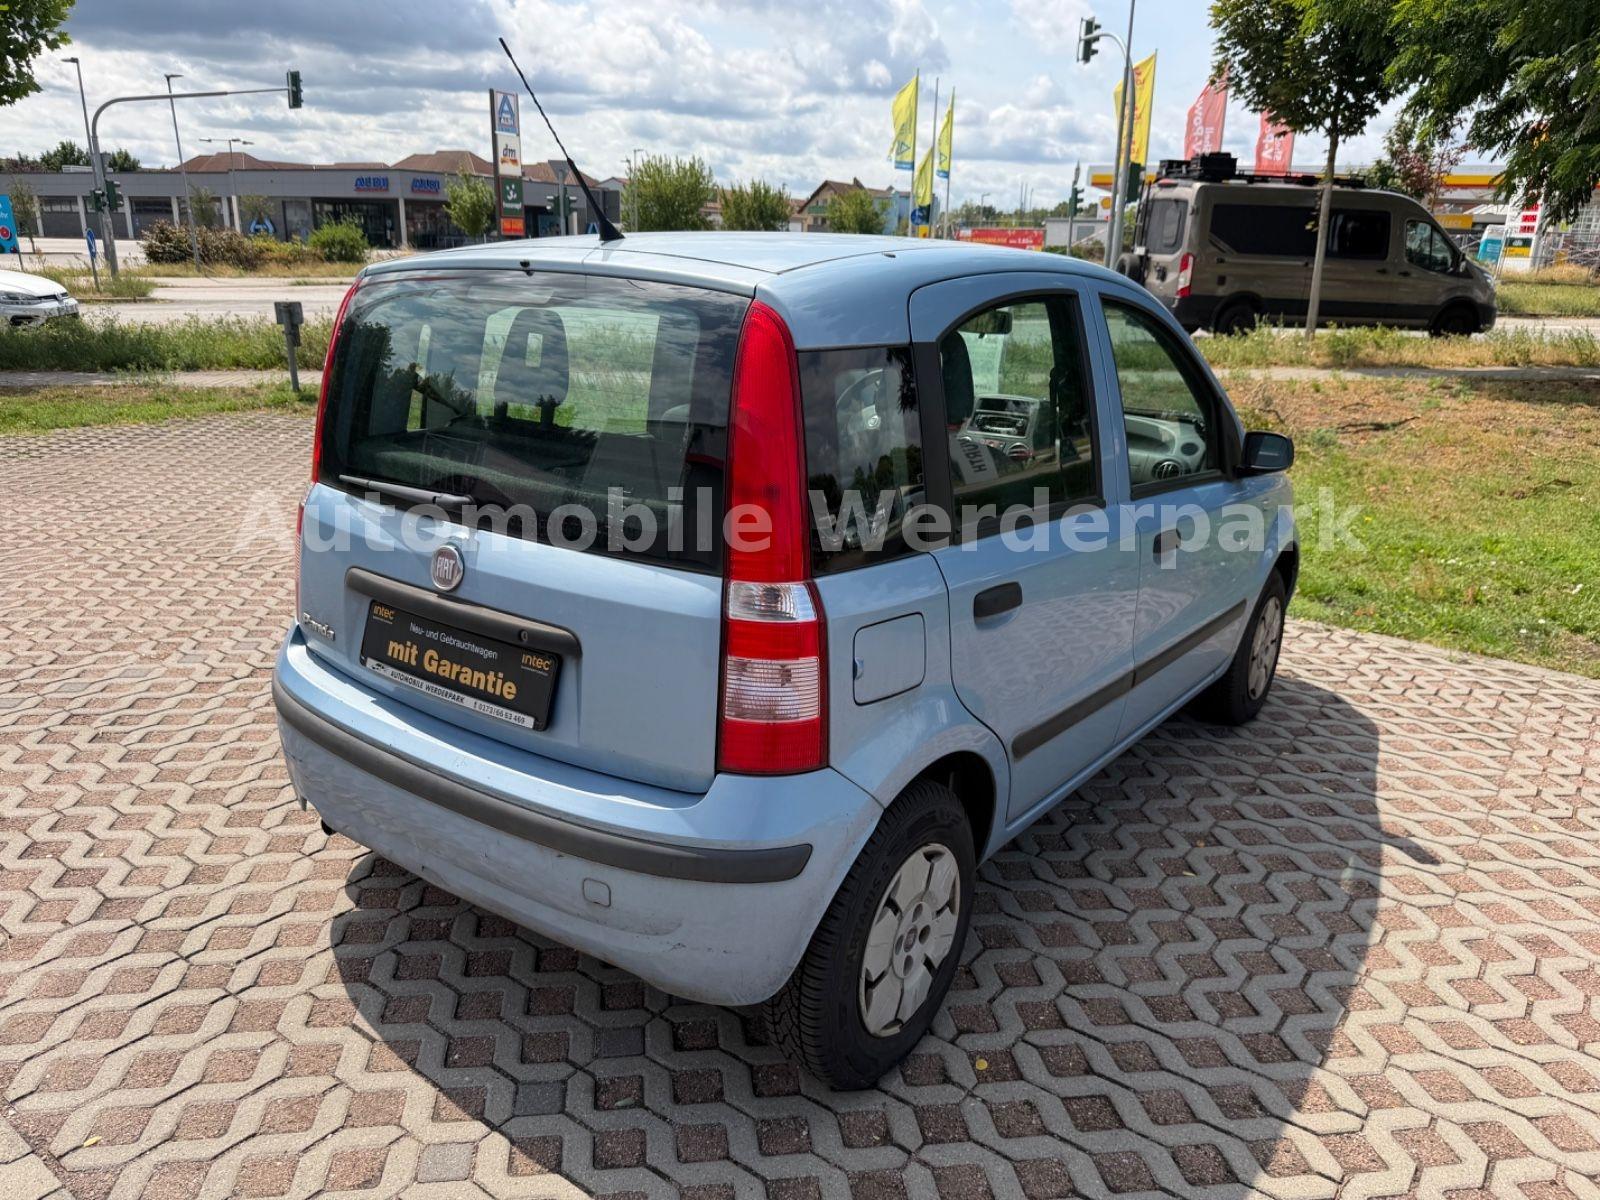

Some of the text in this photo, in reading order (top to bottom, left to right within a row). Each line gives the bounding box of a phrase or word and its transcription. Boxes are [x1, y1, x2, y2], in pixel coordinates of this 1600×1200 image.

[436, 556, 456, 580] FIAT
[373, 605, 395, 620] intec
[426, 630, 438, 640] und
[440, 632, 498, 660] Gebrauchtwagen
[387, 640, 517, 700] mit Garantie
[522, 653, 551, 671] intec
[390, 670, 424, 689] AUTOMOBILE
[425, 684, 465, 703] WERDERPARK
